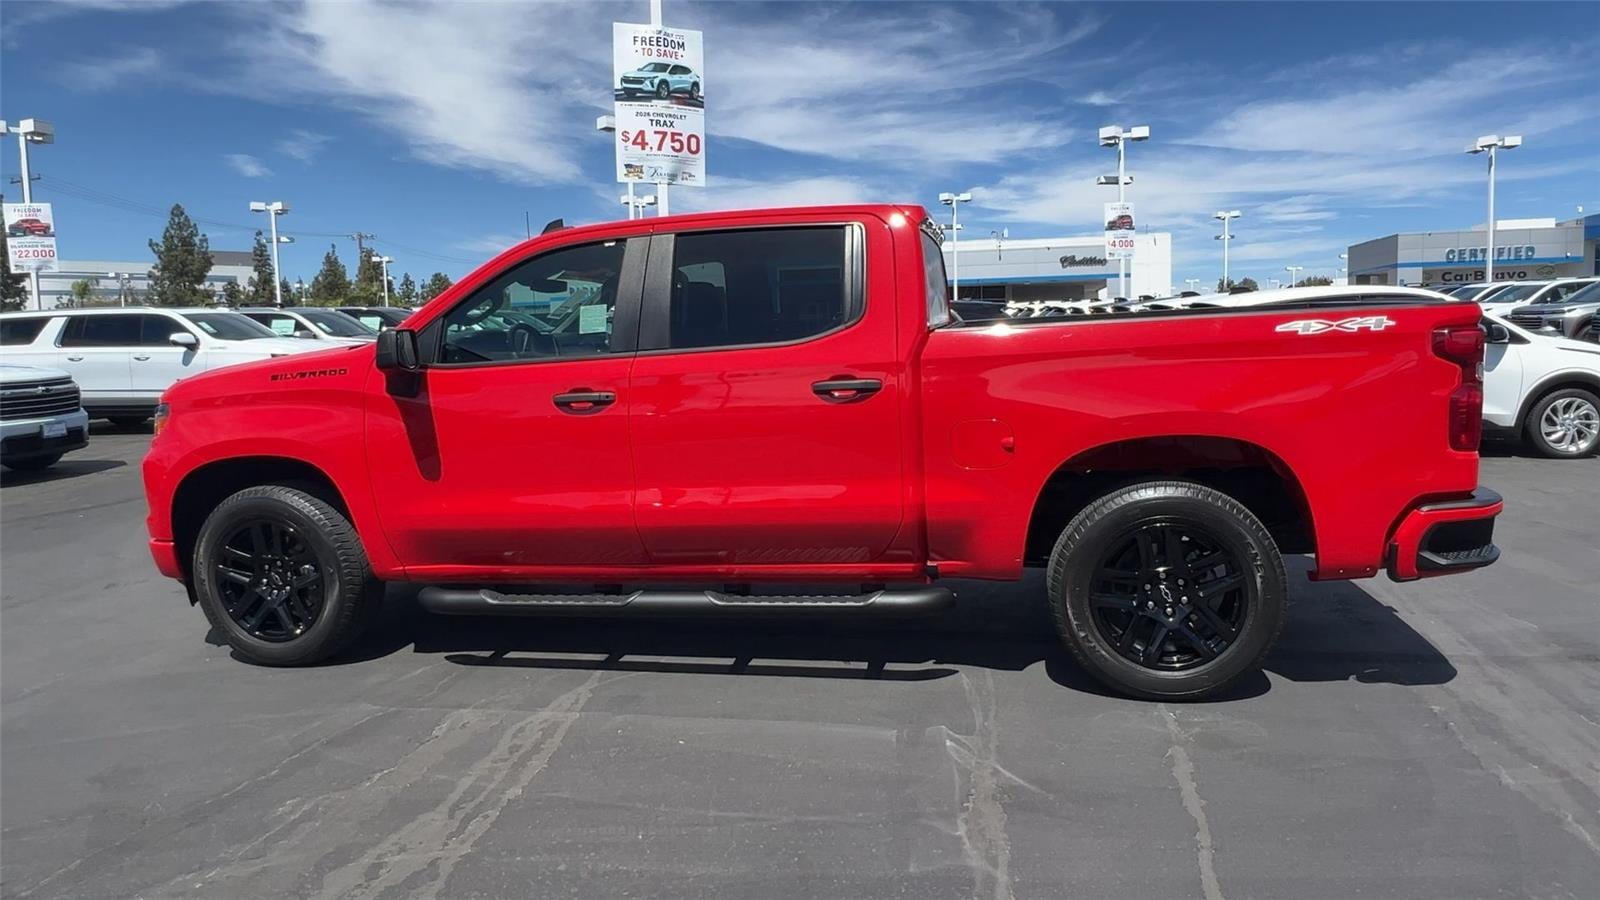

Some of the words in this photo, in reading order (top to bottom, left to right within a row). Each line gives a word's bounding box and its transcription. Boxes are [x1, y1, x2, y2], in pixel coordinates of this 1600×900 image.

[633, 36, 686, 51] FREEDOM
[641, 47, 653, 57] TO
[656, 48, 680, 60] SAVE
[652, 112, 687, 121] CHEVROLET
[649, 119, 675, 128] TRAX
[1059, 254, 1107, 269] Cadillac
[1441, 270, 1527, 282] CarBavo
[270, 368, 347, 381] SILVERADO
